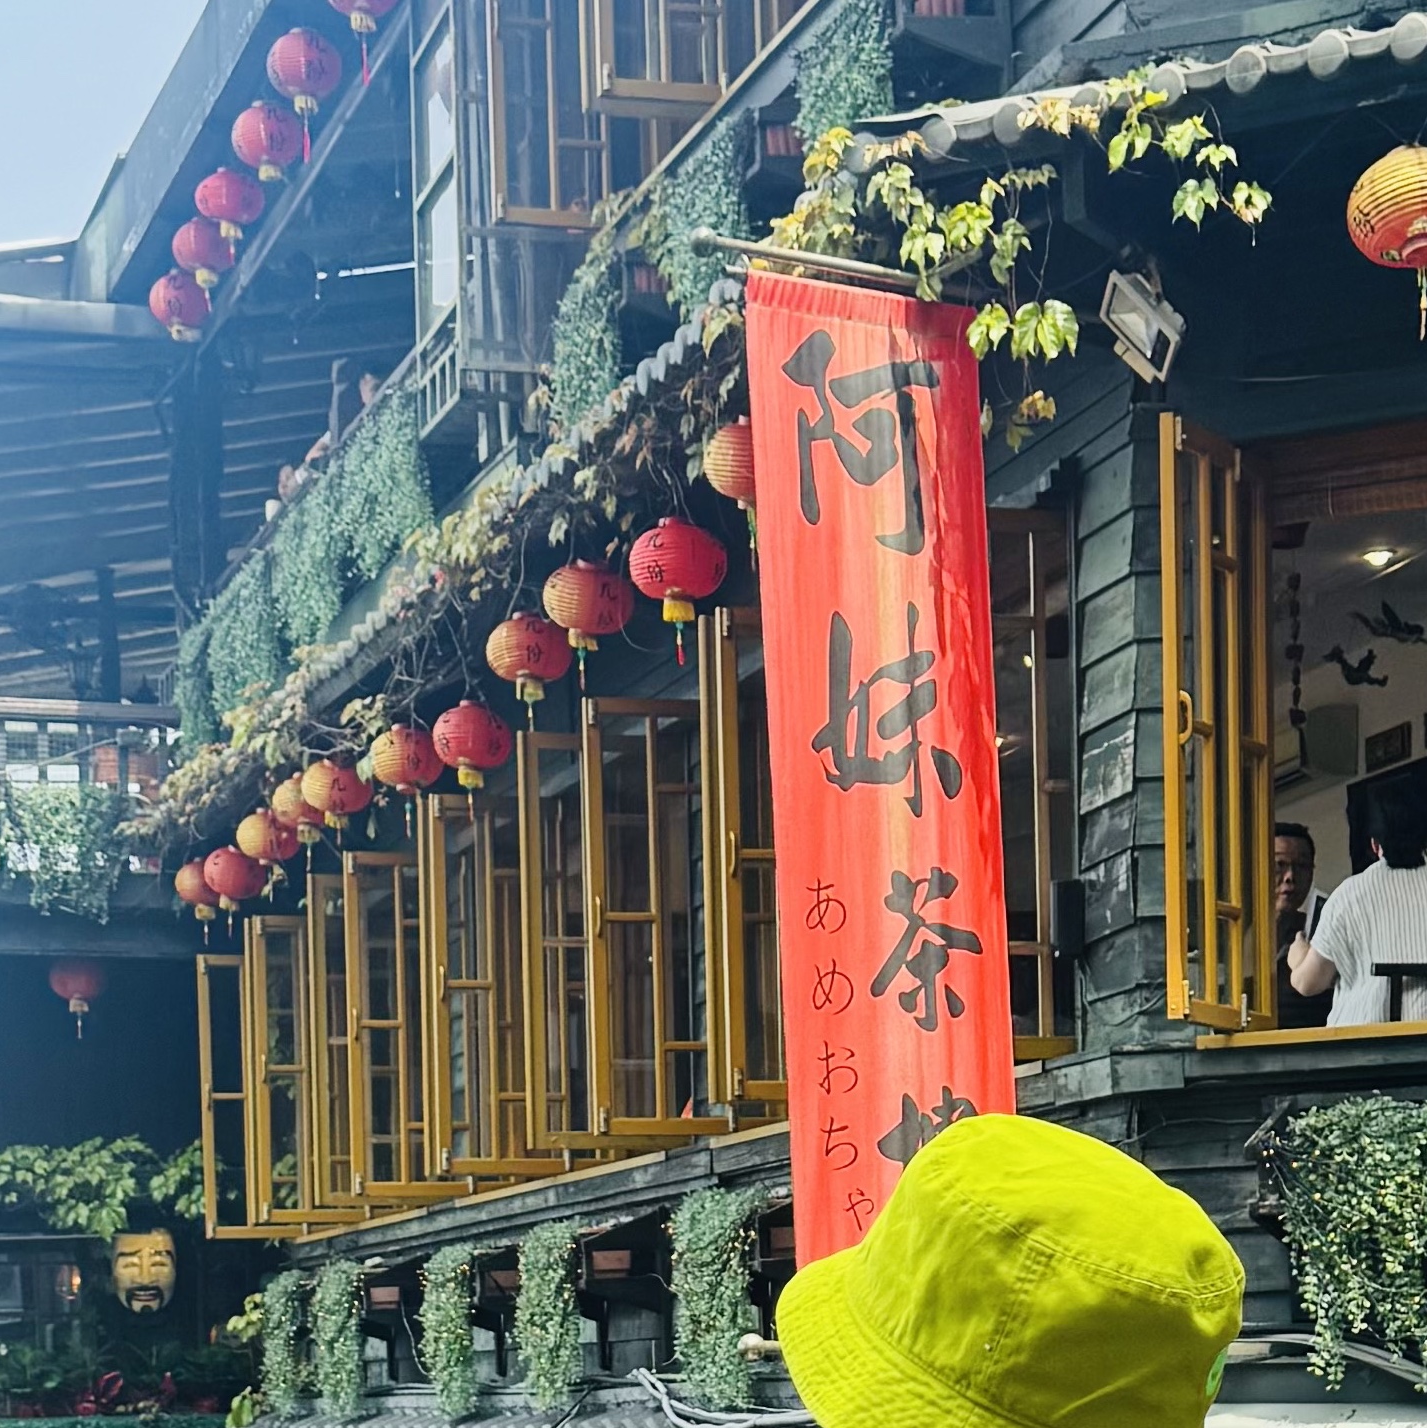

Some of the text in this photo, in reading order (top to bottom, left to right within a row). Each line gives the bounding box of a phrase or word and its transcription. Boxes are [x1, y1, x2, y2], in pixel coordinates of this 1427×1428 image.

[805, 876, 875, 1232] あめおちゃ
